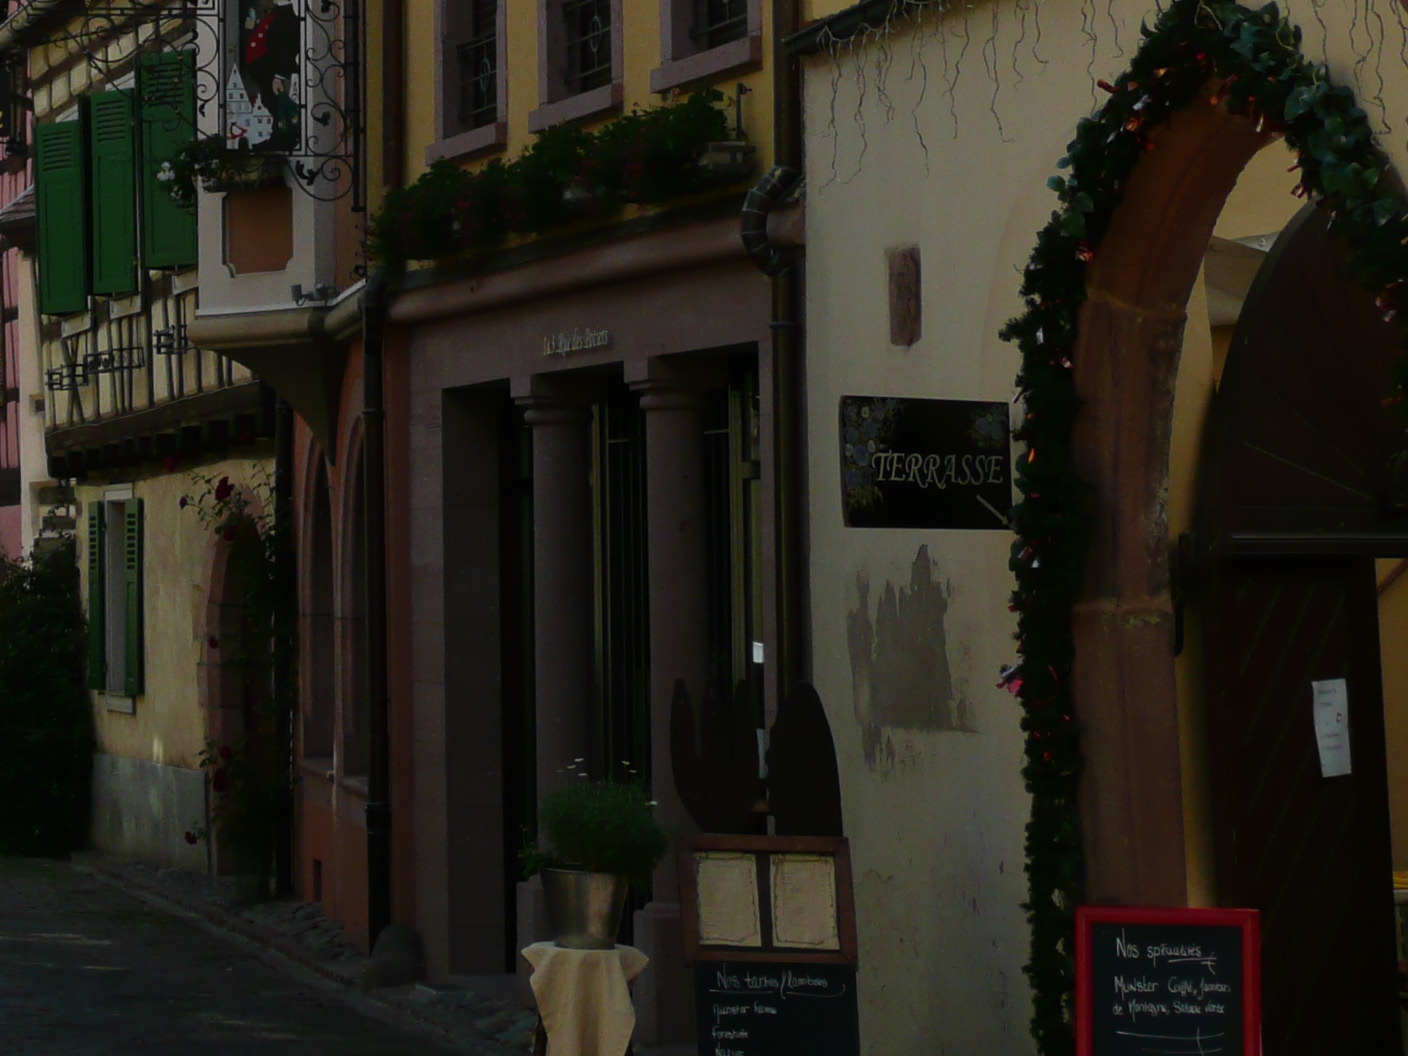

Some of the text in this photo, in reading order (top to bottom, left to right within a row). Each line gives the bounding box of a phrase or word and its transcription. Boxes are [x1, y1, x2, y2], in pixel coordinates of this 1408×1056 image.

[871, 449, 1004, 490] TERRASSE
[1116, 928, 1139, 958] Nos
[717, 962, 740, 989] Nos
[1114, 975, 1159, 1001] Munster
